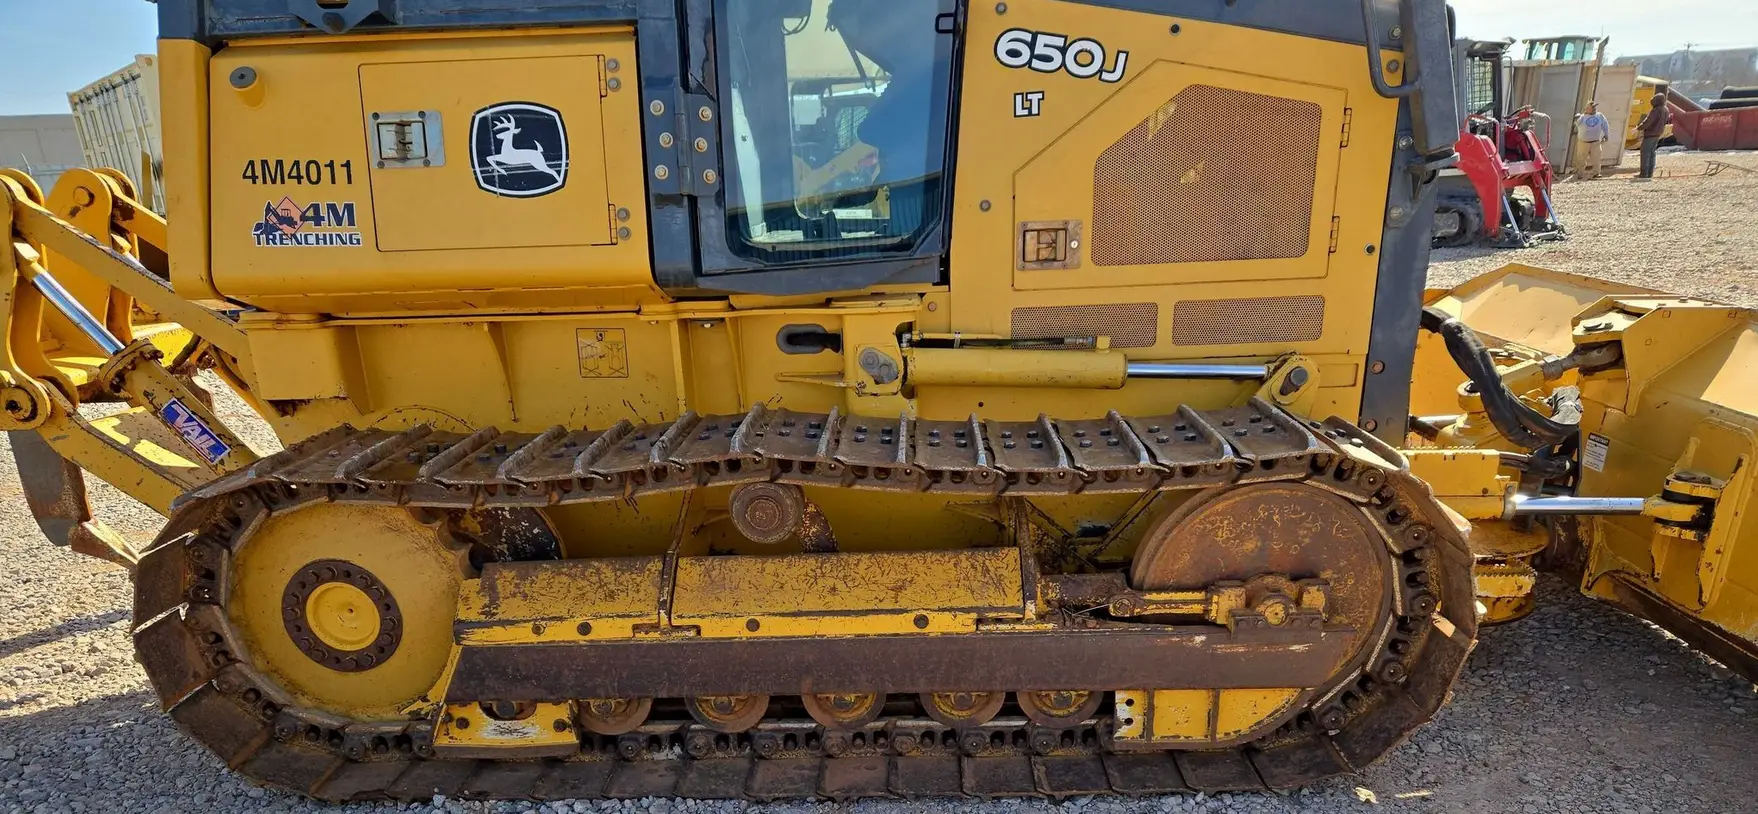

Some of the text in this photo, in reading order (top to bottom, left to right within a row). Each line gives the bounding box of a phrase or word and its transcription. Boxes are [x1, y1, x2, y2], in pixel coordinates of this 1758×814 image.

[994, 28, 1129, 83] 650J
[1014, 91, 1044, 118] LT
[242, 159, 352, 185] 4M4011
[300, 203, 355, 227] 4M
[253, 233, 361, 246] TRENCHING
[171, 404, 216, 458] VAIL
